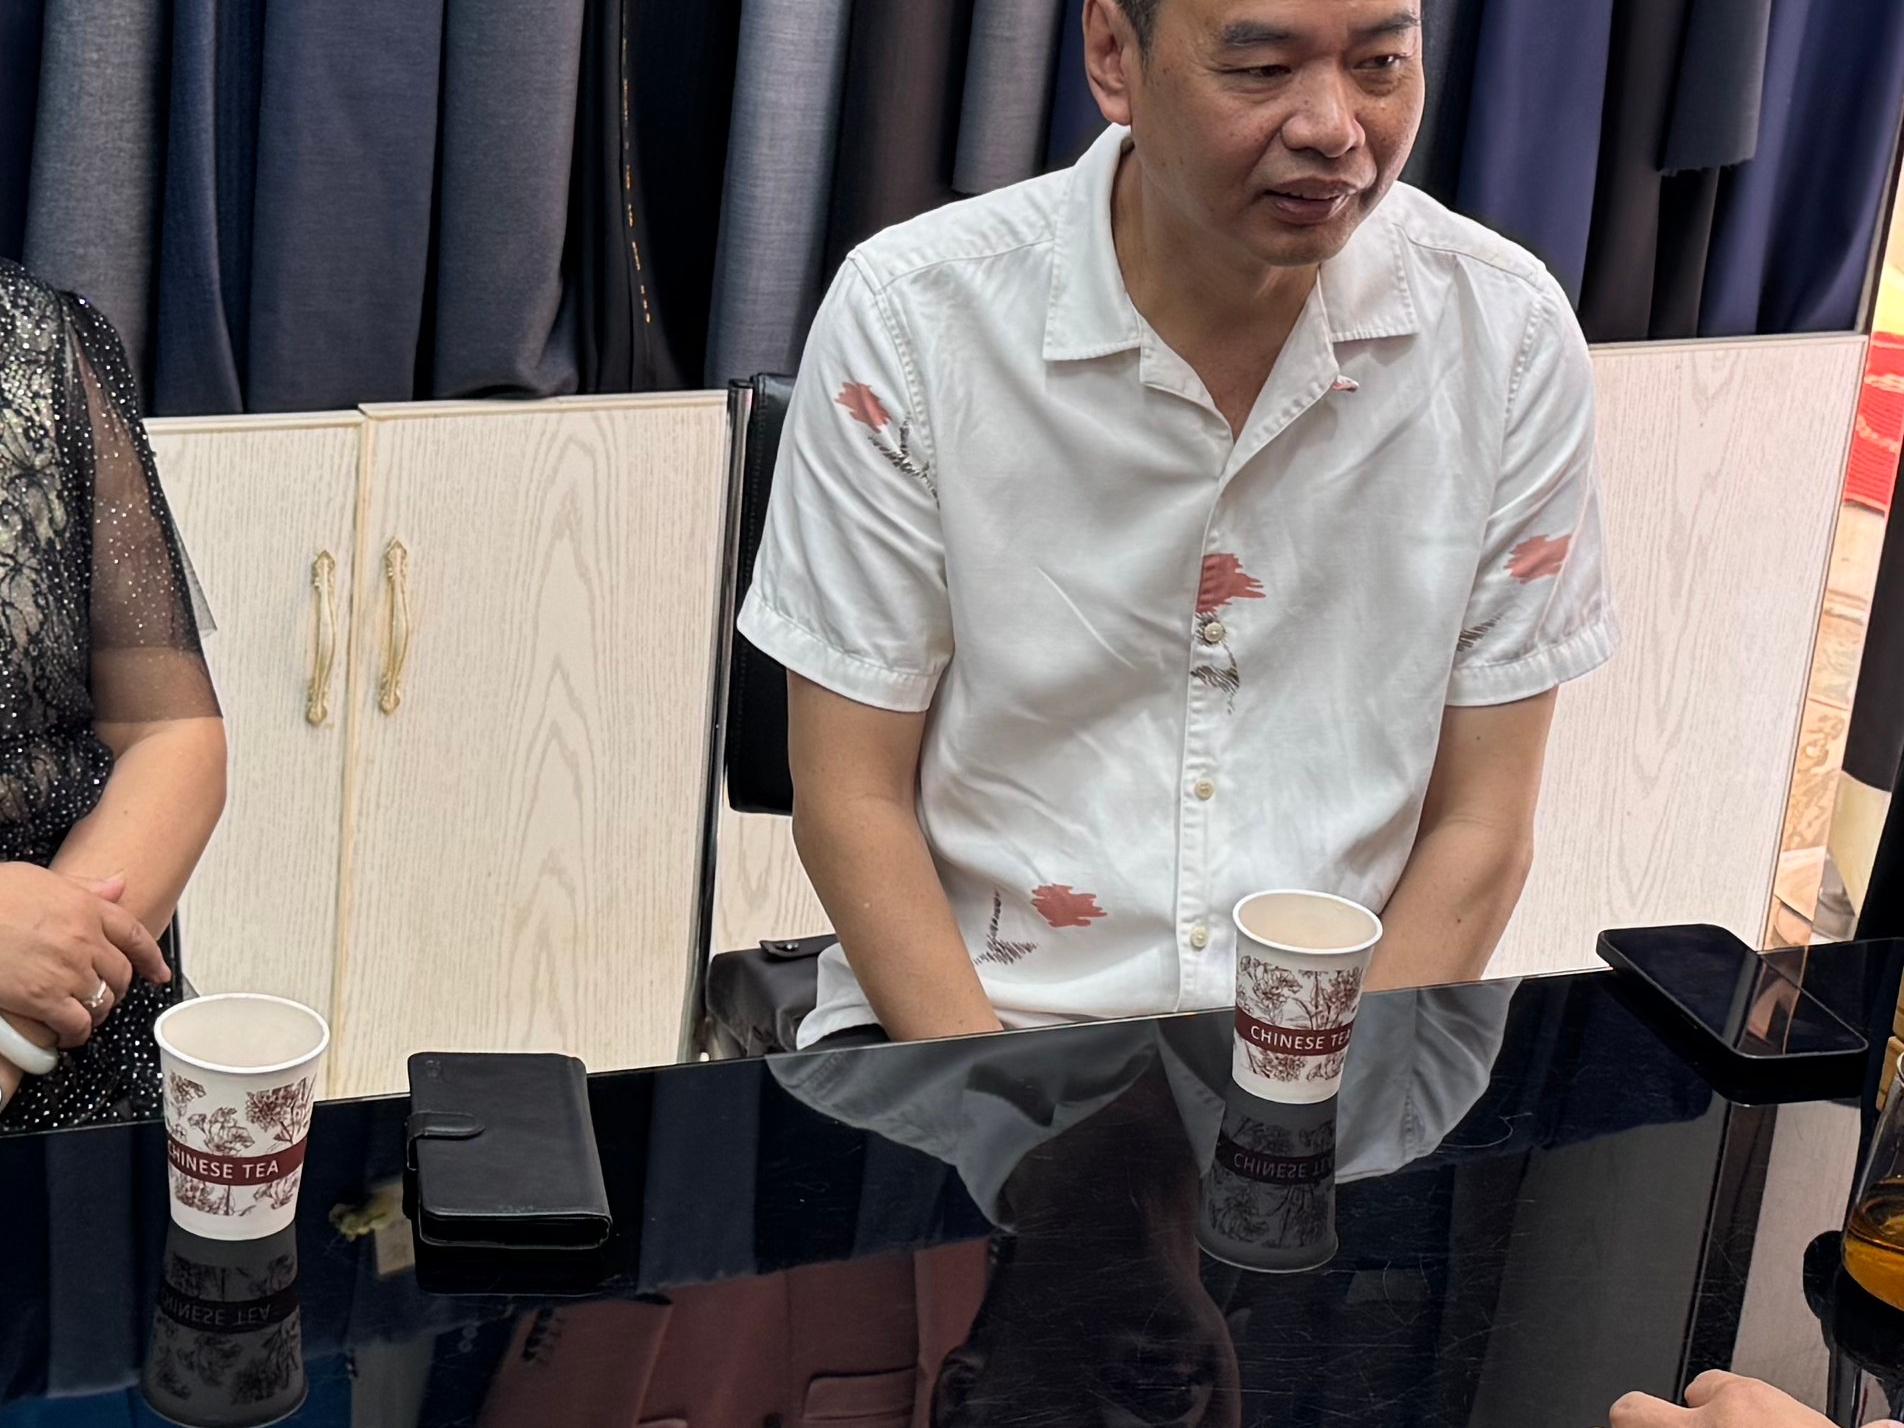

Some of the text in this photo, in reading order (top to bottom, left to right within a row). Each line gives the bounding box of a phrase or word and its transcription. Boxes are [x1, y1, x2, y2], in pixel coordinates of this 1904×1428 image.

[1250, 1026, 1350, 1050] CHINESE TEA
[167, 1139, 279, 1179] CHINESE TEA
